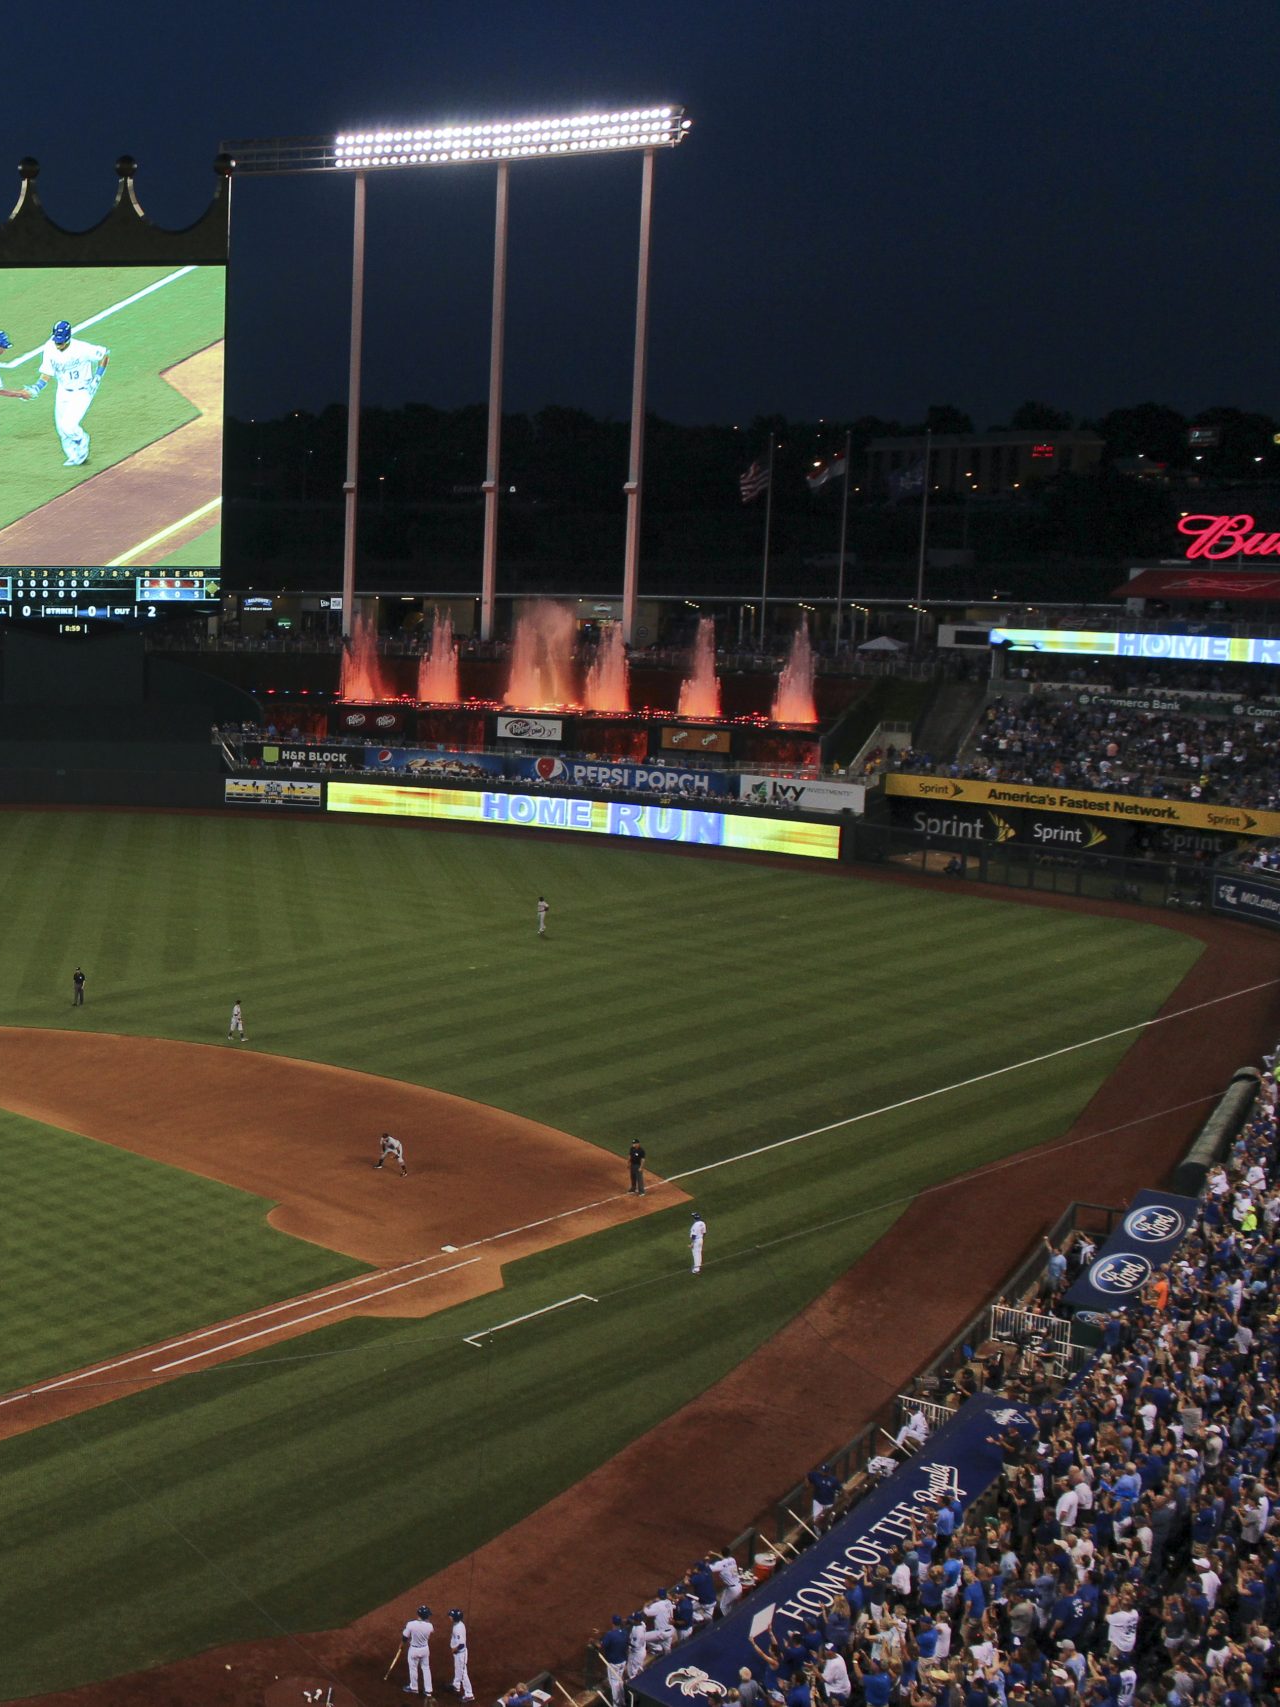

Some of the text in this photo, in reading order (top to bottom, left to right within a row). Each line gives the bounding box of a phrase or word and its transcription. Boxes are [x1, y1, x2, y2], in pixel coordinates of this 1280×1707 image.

[22, 606, 31, 616] 0
[88, 606, 96, 616] 0
[148, 606, 156, 617] 2
[1119, 633, 1230, 661] HOME
[1152, 700, 1181, 711] Bank
[281, 750, 347, 763] H&R BLOCK
[574, 764, 709, 793] PEPSI PORCH
[919, 783, 948, 795] Sprint
[988, 788, 1180, 820] America's Fastest Network.
[481, 791, 723, 846] HOME RUN
[914, 811, 984, 840] Sprint
[1207, 813, 1241, 826] Sprint
[1033, 823, 1083, 843] Sprint
[777, 1462, 968, 1621] HOME OF THE Royals
